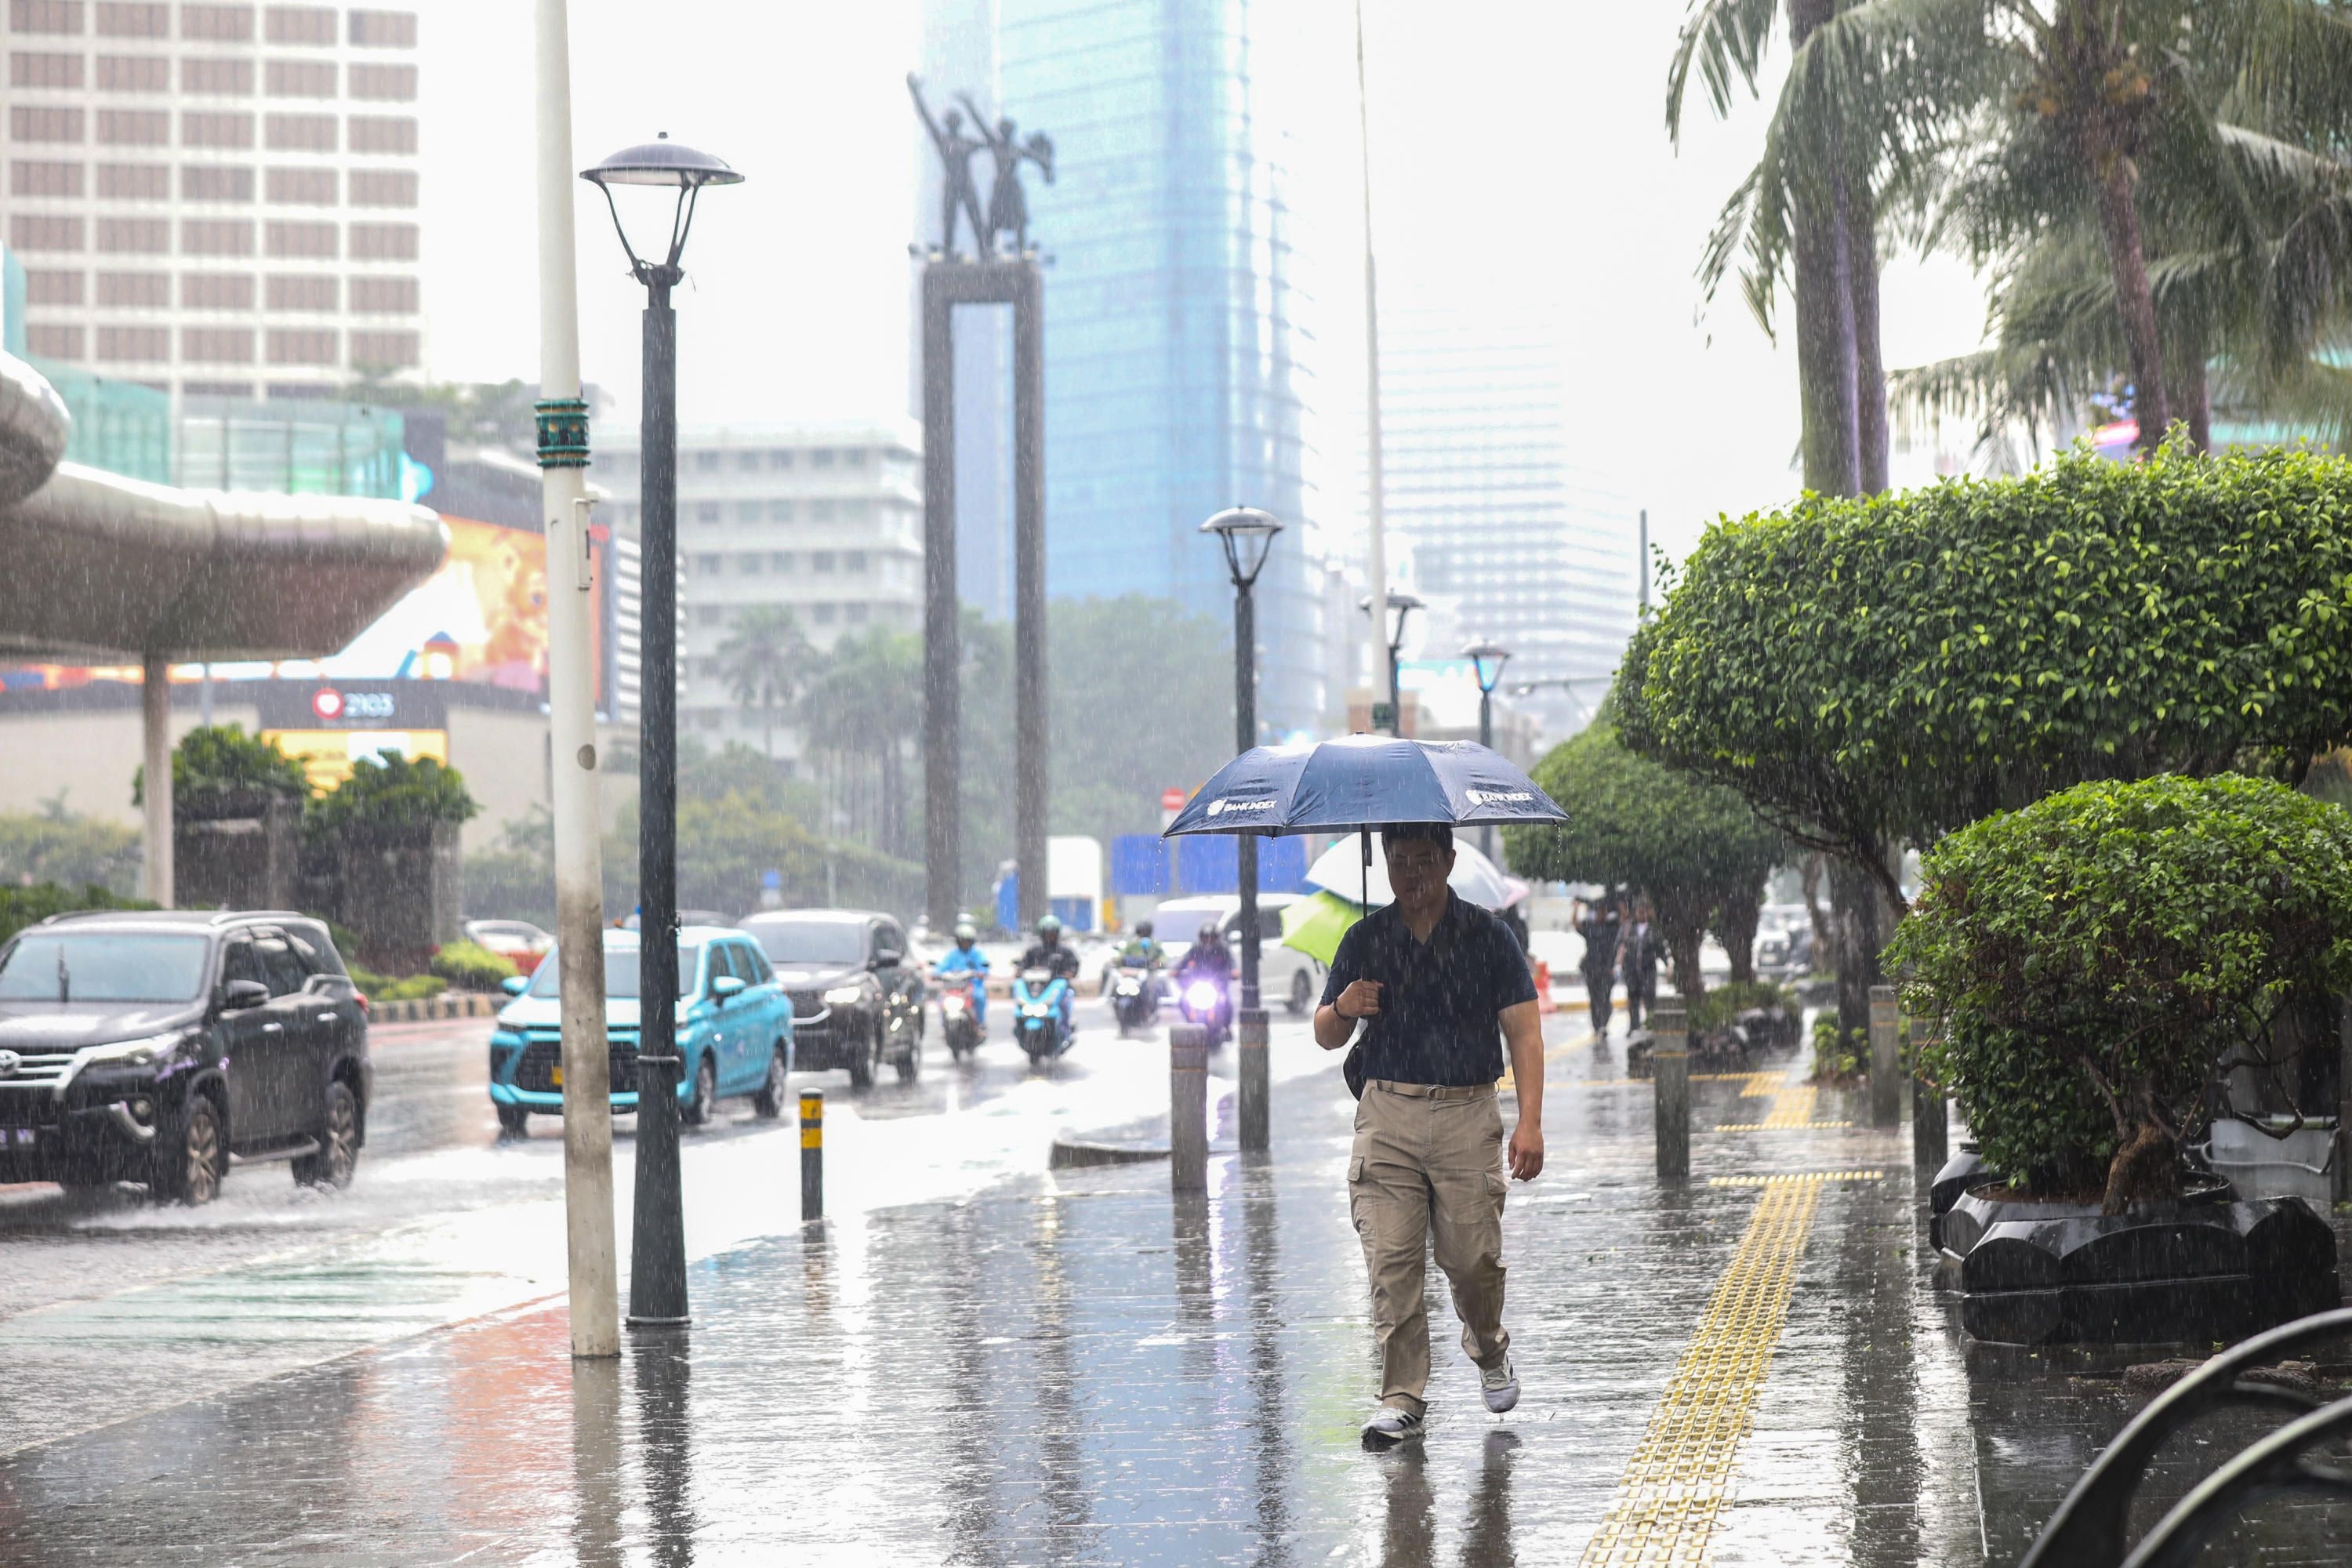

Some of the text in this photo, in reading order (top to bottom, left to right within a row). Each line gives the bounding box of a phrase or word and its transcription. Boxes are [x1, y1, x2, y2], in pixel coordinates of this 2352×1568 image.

[1481, 793, 1534, 802] BANK INDEX
[1223, 800, 1277, 811] BANK INDEX
